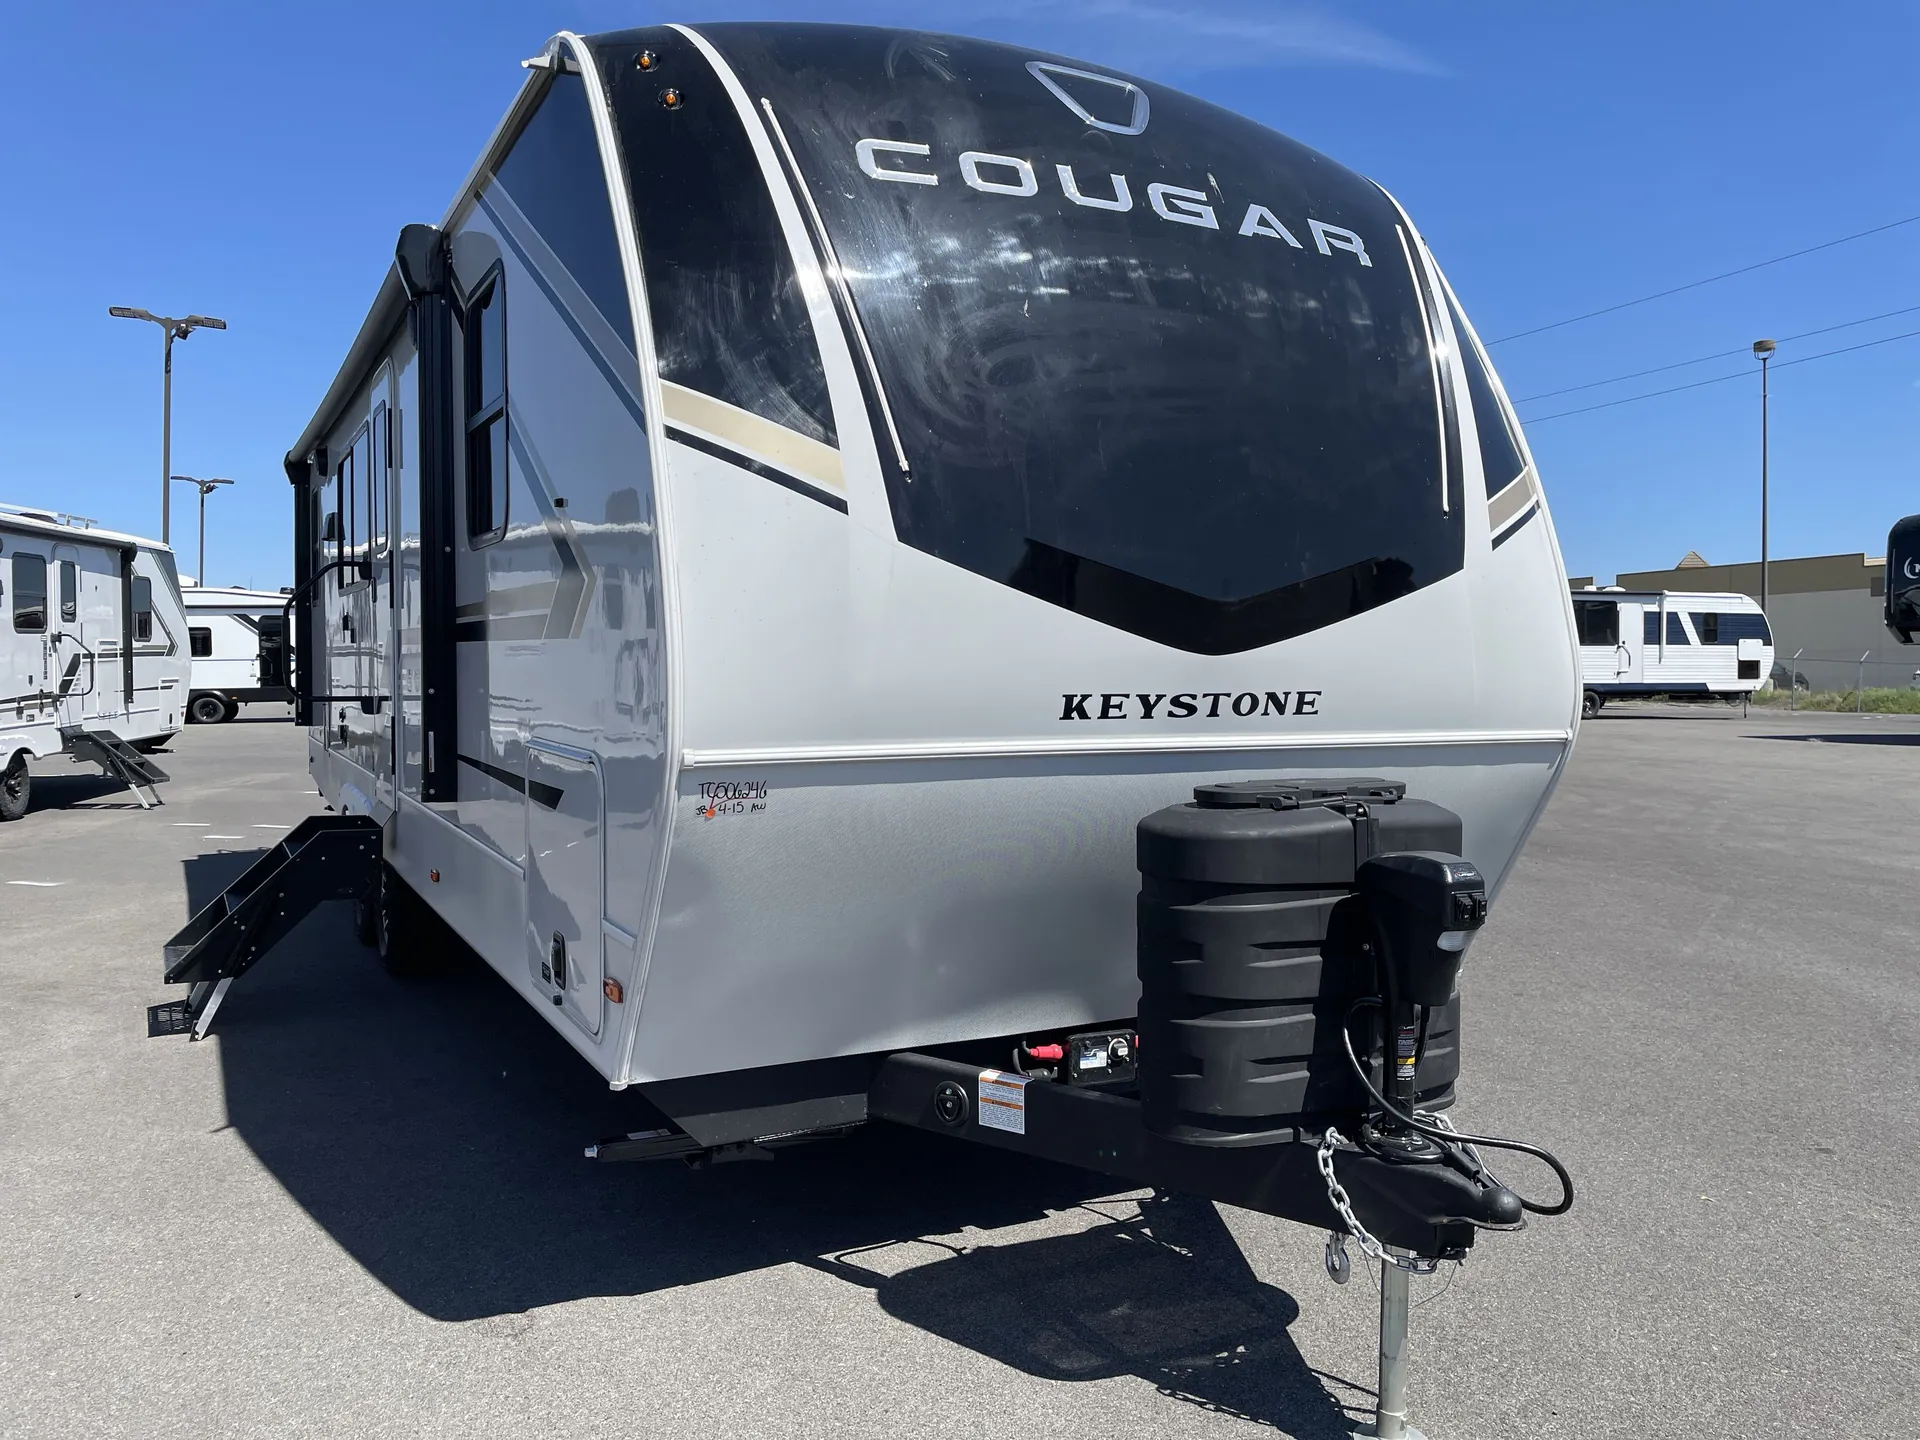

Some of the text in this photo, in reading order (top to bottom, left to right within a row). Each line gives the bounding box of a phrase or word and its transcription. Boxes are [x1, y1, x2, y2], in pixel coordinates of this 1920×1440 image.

[855, 138, 1373, 267] COUGAR
[1059, 691, 1322, 720] KEYSTONE
[718, 801, 744, 815] 4-15
